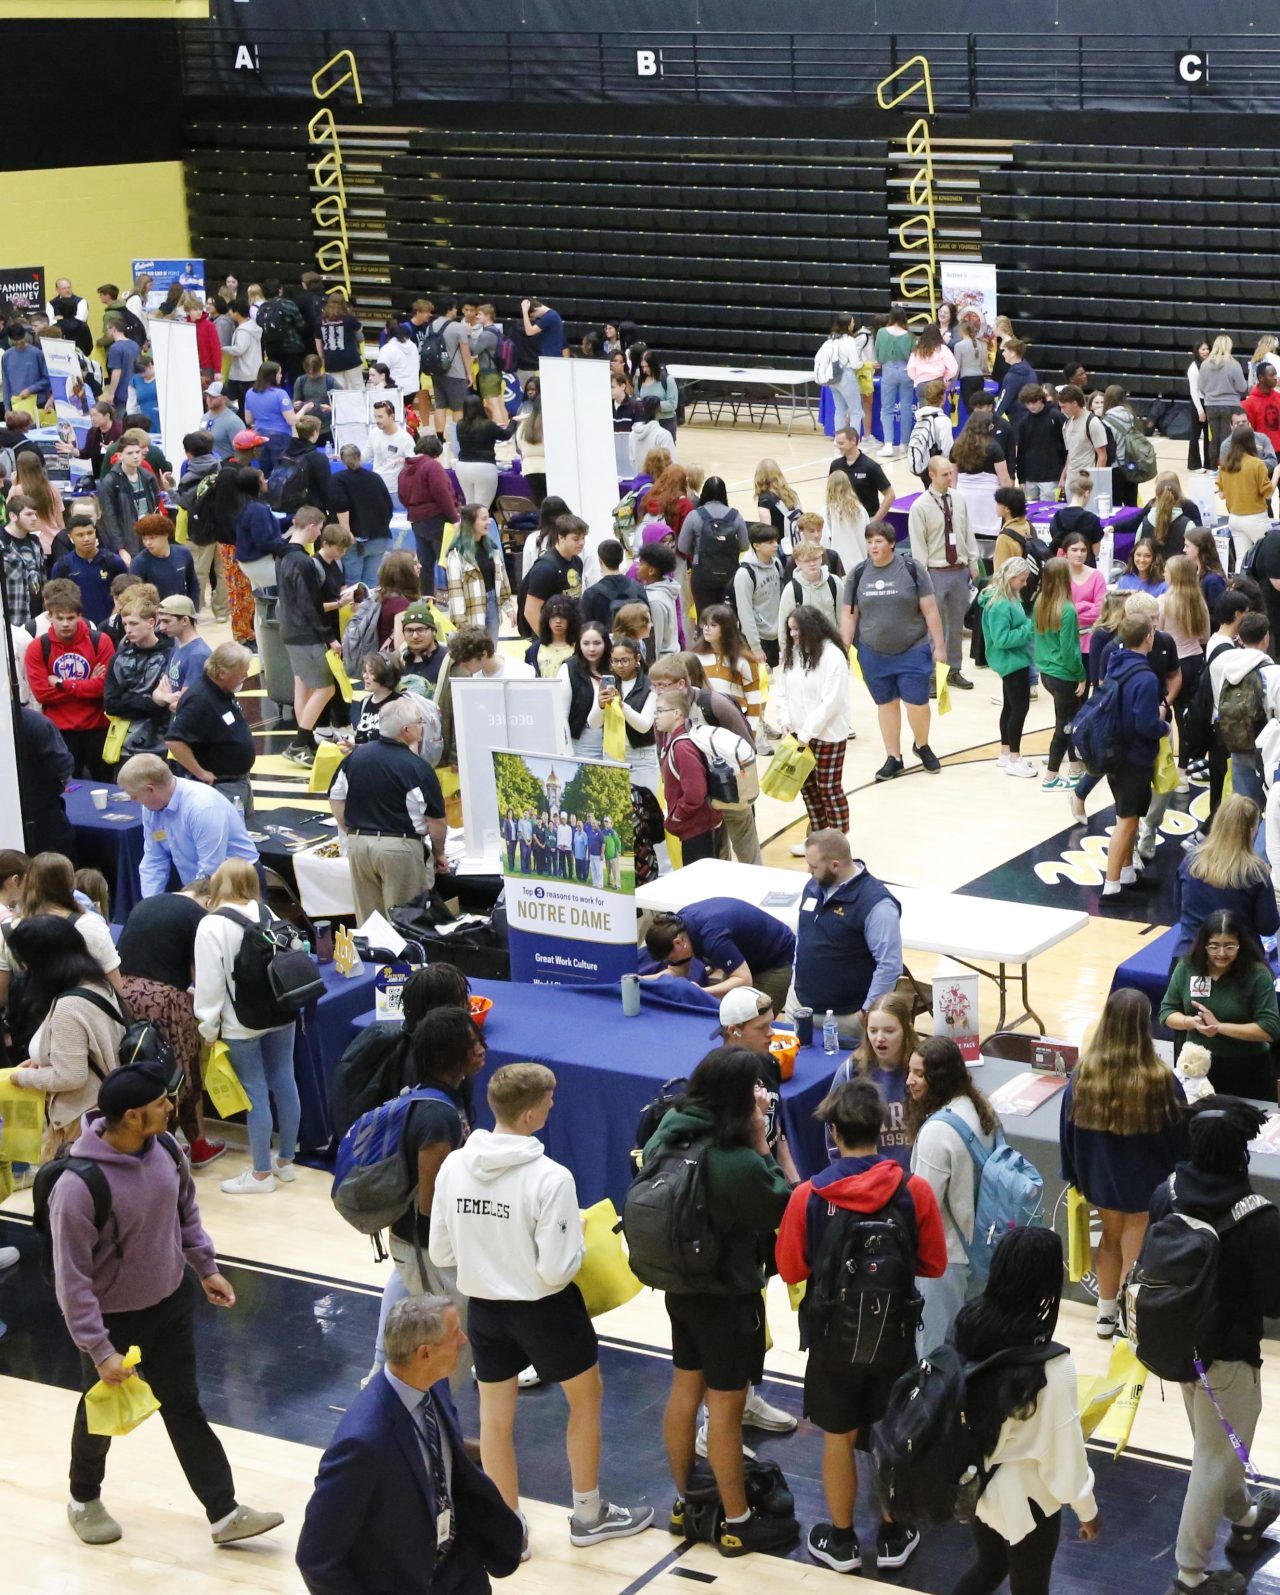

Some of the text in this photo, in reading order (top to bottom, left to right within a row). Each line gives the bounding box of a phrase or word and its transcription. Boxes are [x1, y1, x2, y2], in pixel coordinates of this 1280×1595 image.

[235, 46, 253, 68] A
[637, 51, 656, 75] B
[1180, 55, 1202, 81] C
[522, 886, 534, 898] Top
[546, 892, 572, 902] reasons
[572, 894, 580, 903] to
[580, 896, 595, 905] work
[595, 897, 605, 907] for
[517, 900, 612, 932] NOTRE DAME
[535, 953, 598, 971] Great Work Culture
[457, 1198, 510, 1220] TEMELES
